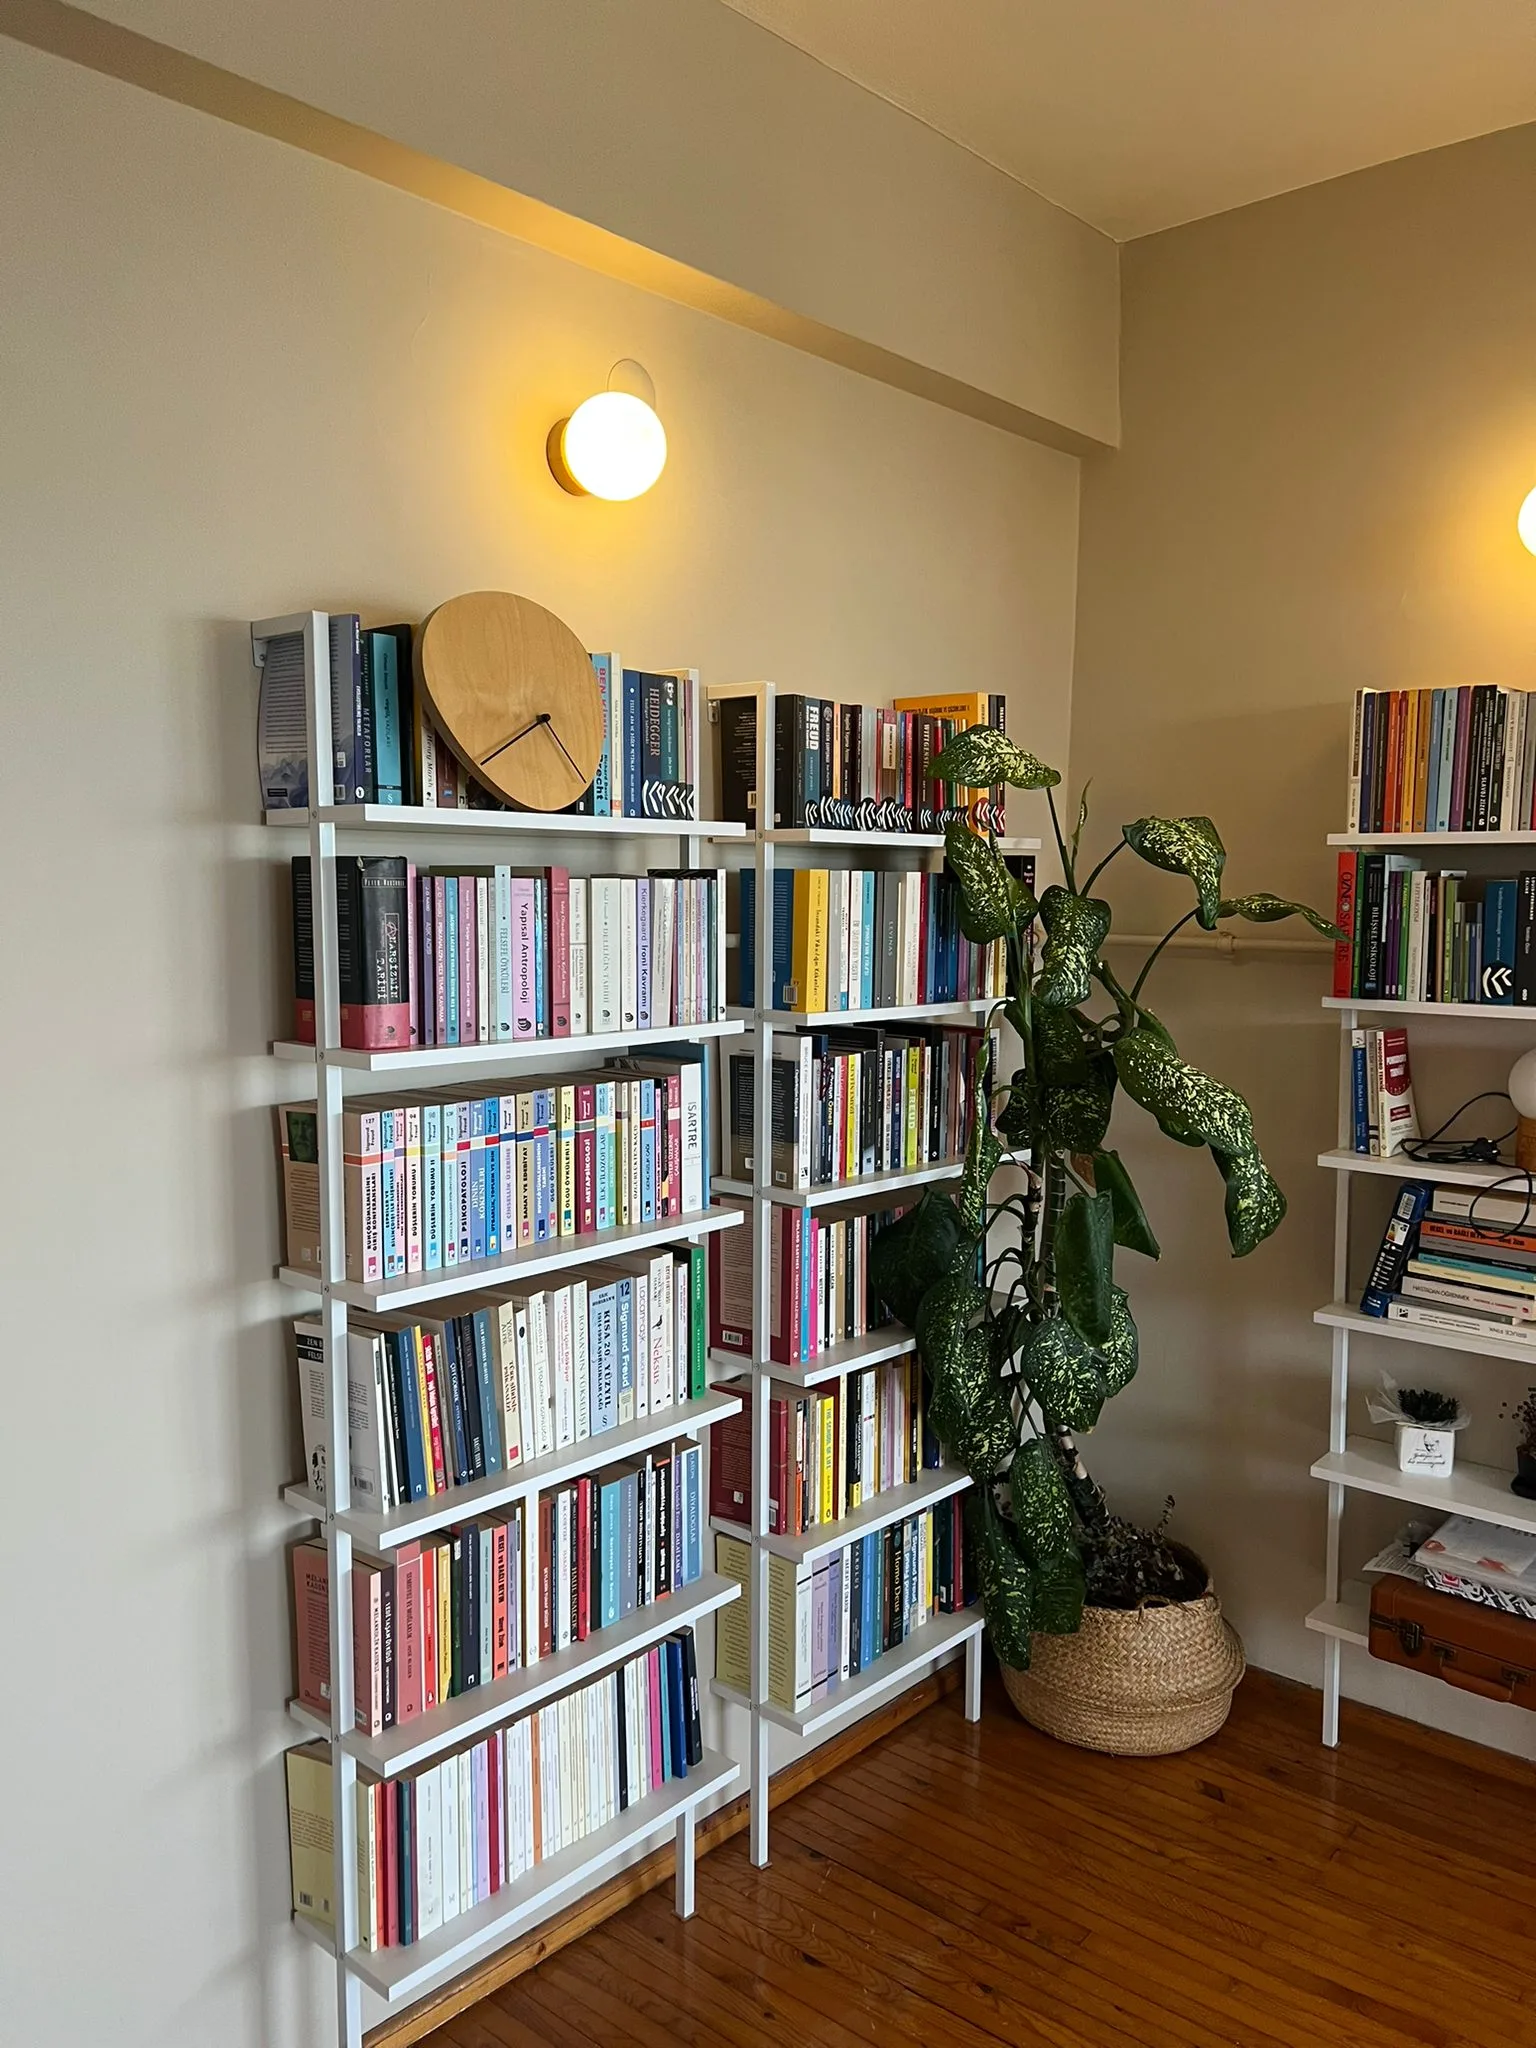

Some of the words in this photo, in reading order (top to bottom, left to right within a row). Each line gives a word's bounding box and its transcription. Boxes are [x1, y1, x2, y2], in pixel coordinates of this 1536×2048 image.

[364, 708, 372, 773] METAFORLAR
[650, 688, 660, 756] HEIDEGGER
[809, 706, 819, 750] FREUD
[520, 903, 529, 940] Yapısal
[520, 944, 530, 1004] Antropoloji
[908, 1087, 916, 1129] FREUD
[459, 1161, 467, 1232] PSİKOPATOLOJİ
[620, 1281, 630, 1297] 12
[619, 1302, 629, 1353] Sigmund
[622, 1355, 630, 1387] Freud
[653, 1336, 663, 1385] Neksus
[604, 1364, 613, 1409] YÜZYIL
[894, 1550, 902, 1584] Homo
